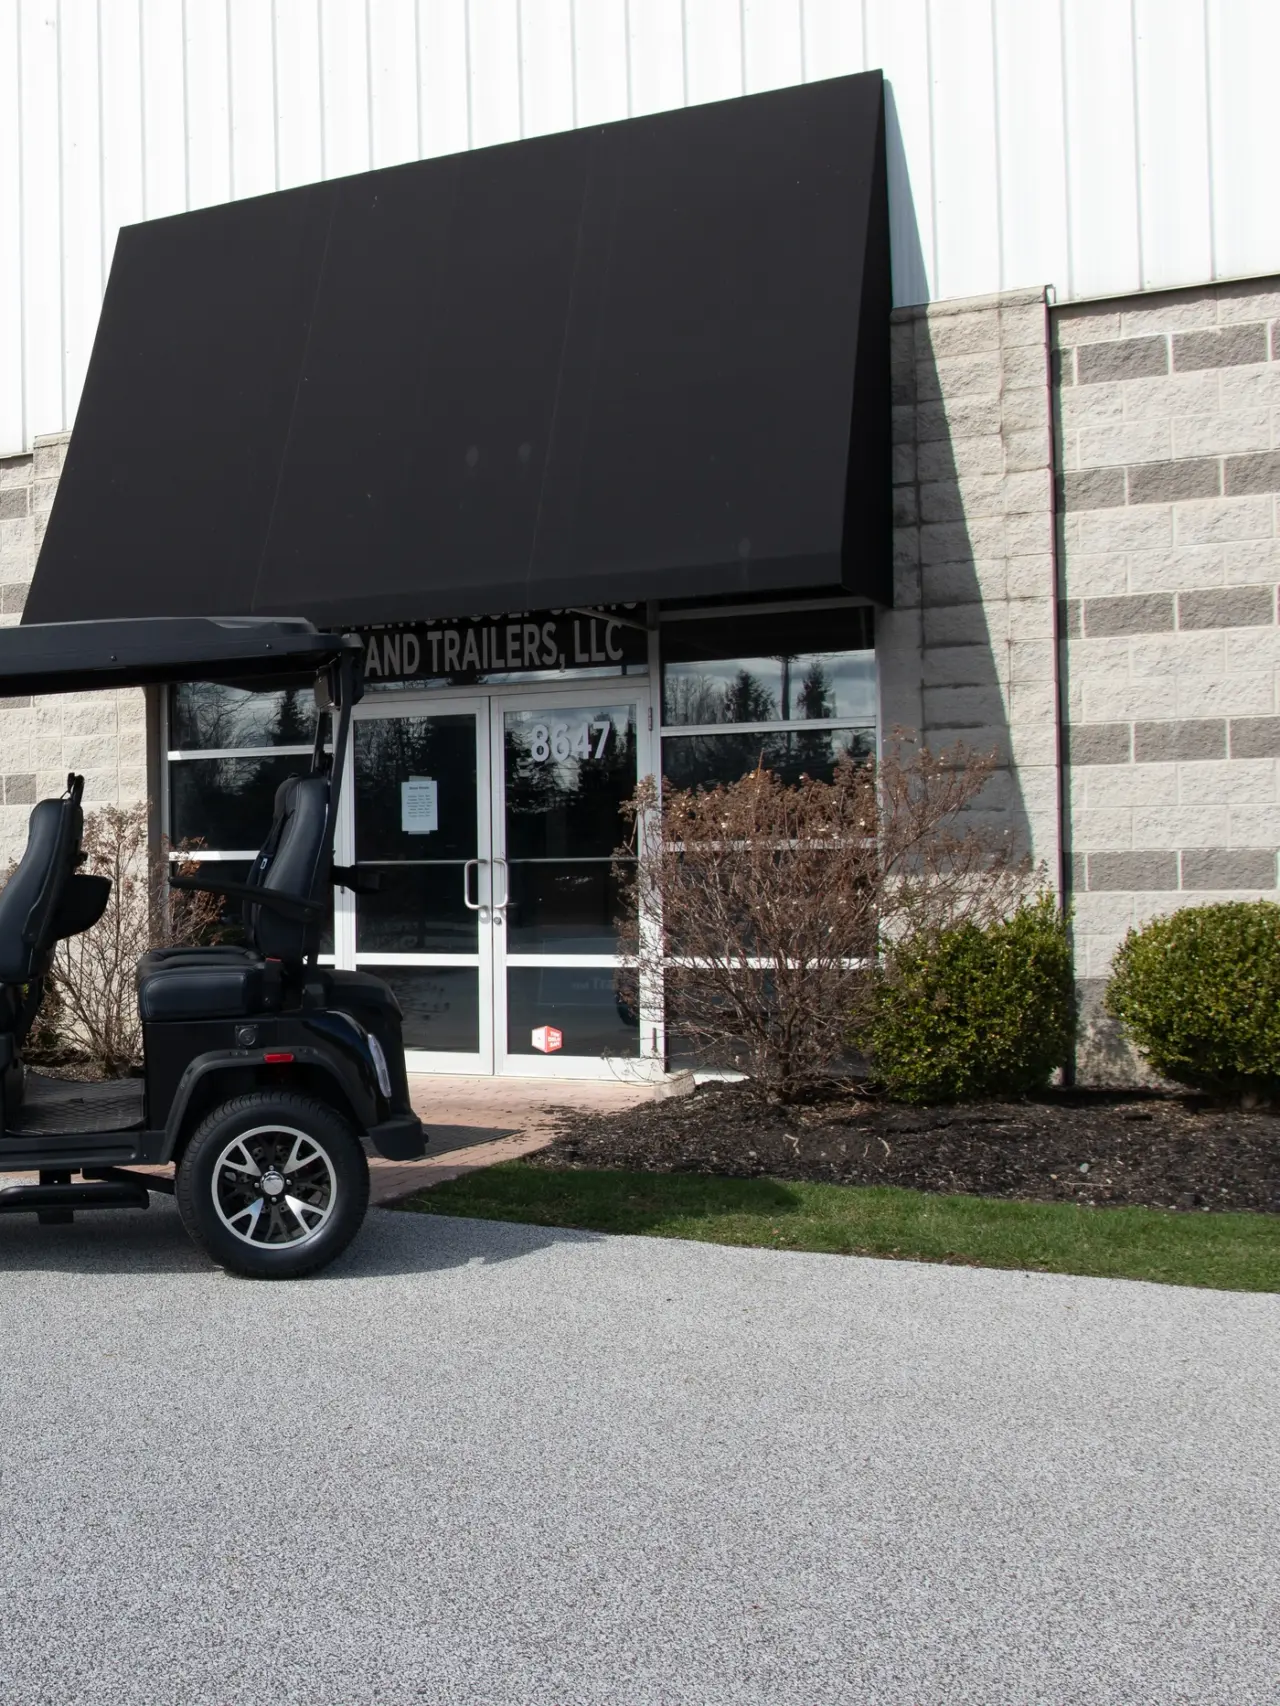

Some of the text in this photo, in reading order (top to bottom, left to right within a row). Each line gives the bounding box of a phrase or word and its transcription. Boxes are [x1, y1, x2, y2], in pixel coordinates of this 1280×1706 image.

[365, 618, 624, 677] AND TRAILERS, LLC
[531, 721, 610, 762] 8647
